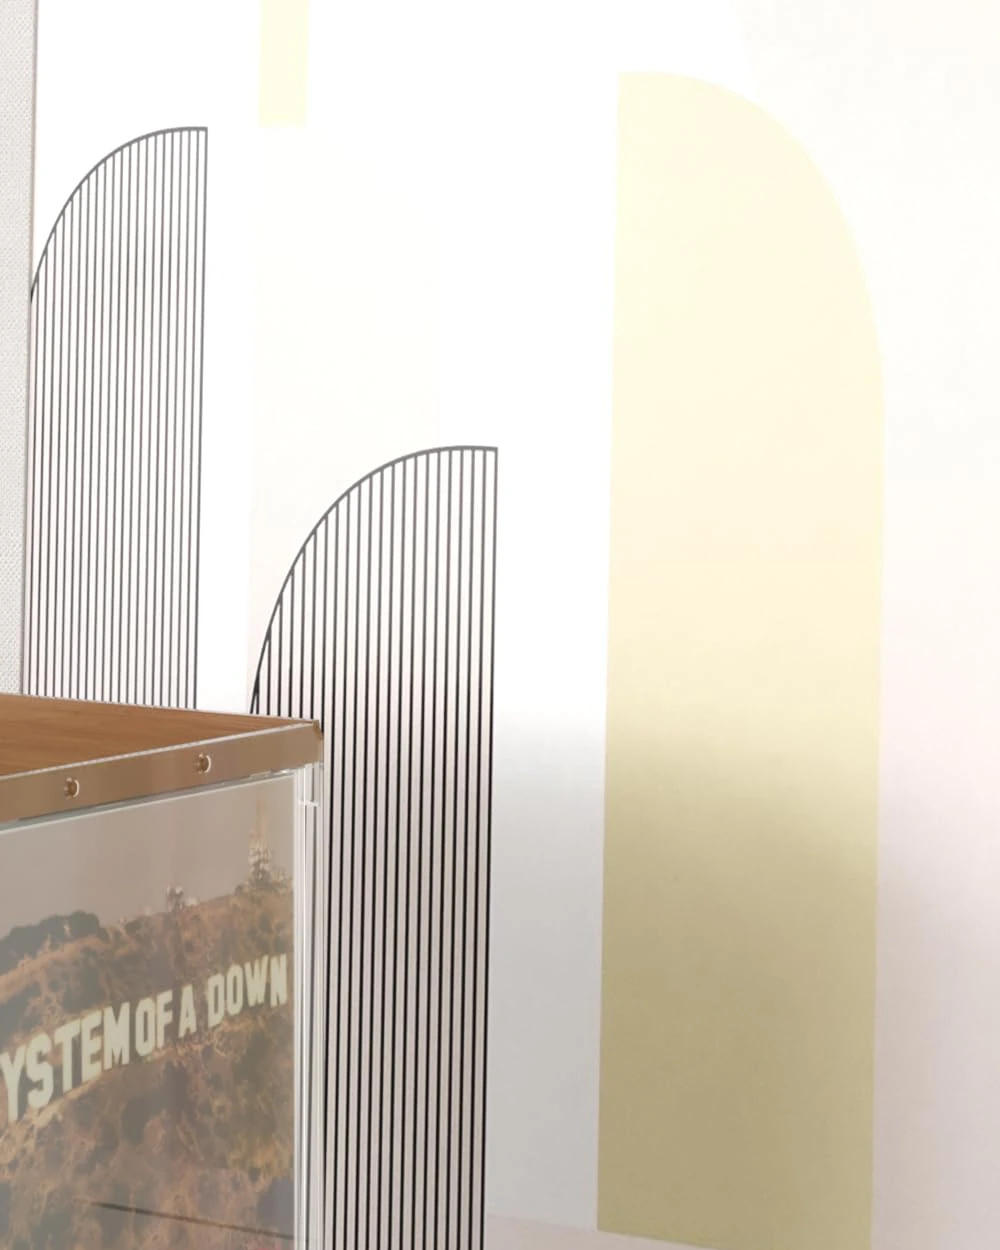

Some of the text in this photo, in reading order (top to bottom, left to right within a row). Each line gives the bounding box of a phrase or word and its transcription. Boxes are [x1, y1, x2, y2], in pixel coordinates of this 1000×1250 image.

[134, 990, 174, 1057] OF
[178, 985, 197, 1038] A
[207, 953, 288, 1028] DOWN
